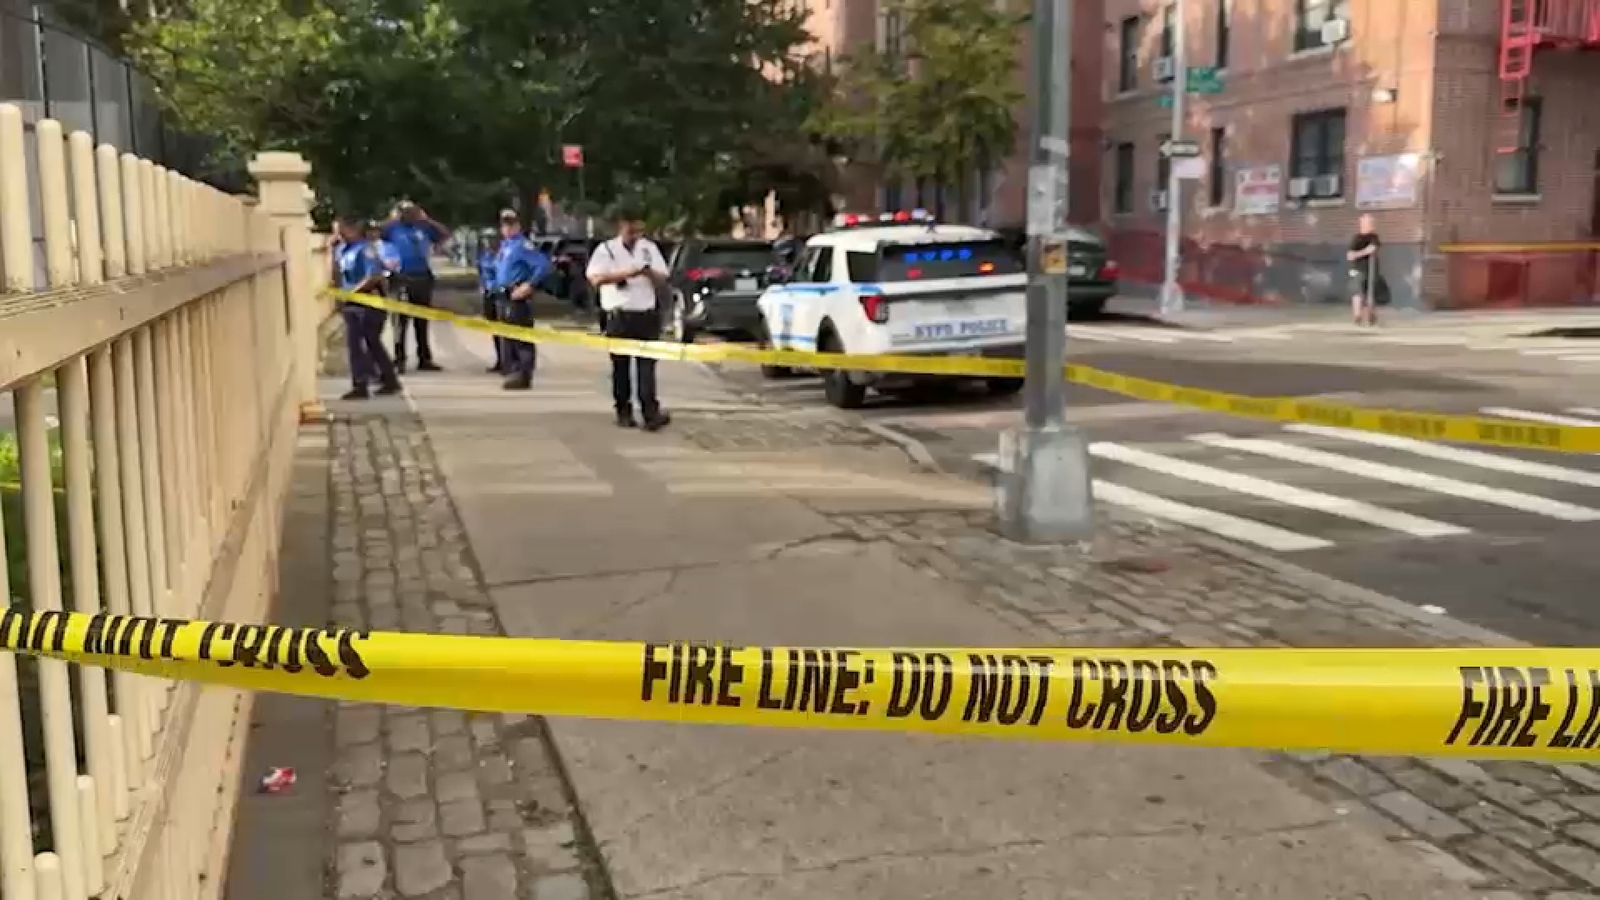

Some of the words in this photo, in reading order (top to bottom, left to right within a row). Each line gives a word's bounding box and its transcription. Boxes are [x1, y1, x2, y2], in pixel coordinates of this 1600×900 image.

[915, 324, 953, 337] NYPD
[960, 319, 1007, 334] POLICE
[0, 610, 70, 652] DO
[84, 614, 188, 660] NOT
[199, 622, 369, 679] CROSS
[641, 644, 744, 707] FIRE
[757, 649, 874, 715] LINE:
[886, 652, 953, 721] DO
[962, 654, 1053, 726] NOT
[1066, 656, 1217, 736] CROSS
[1444, 667, 1551, 747] FIRE
